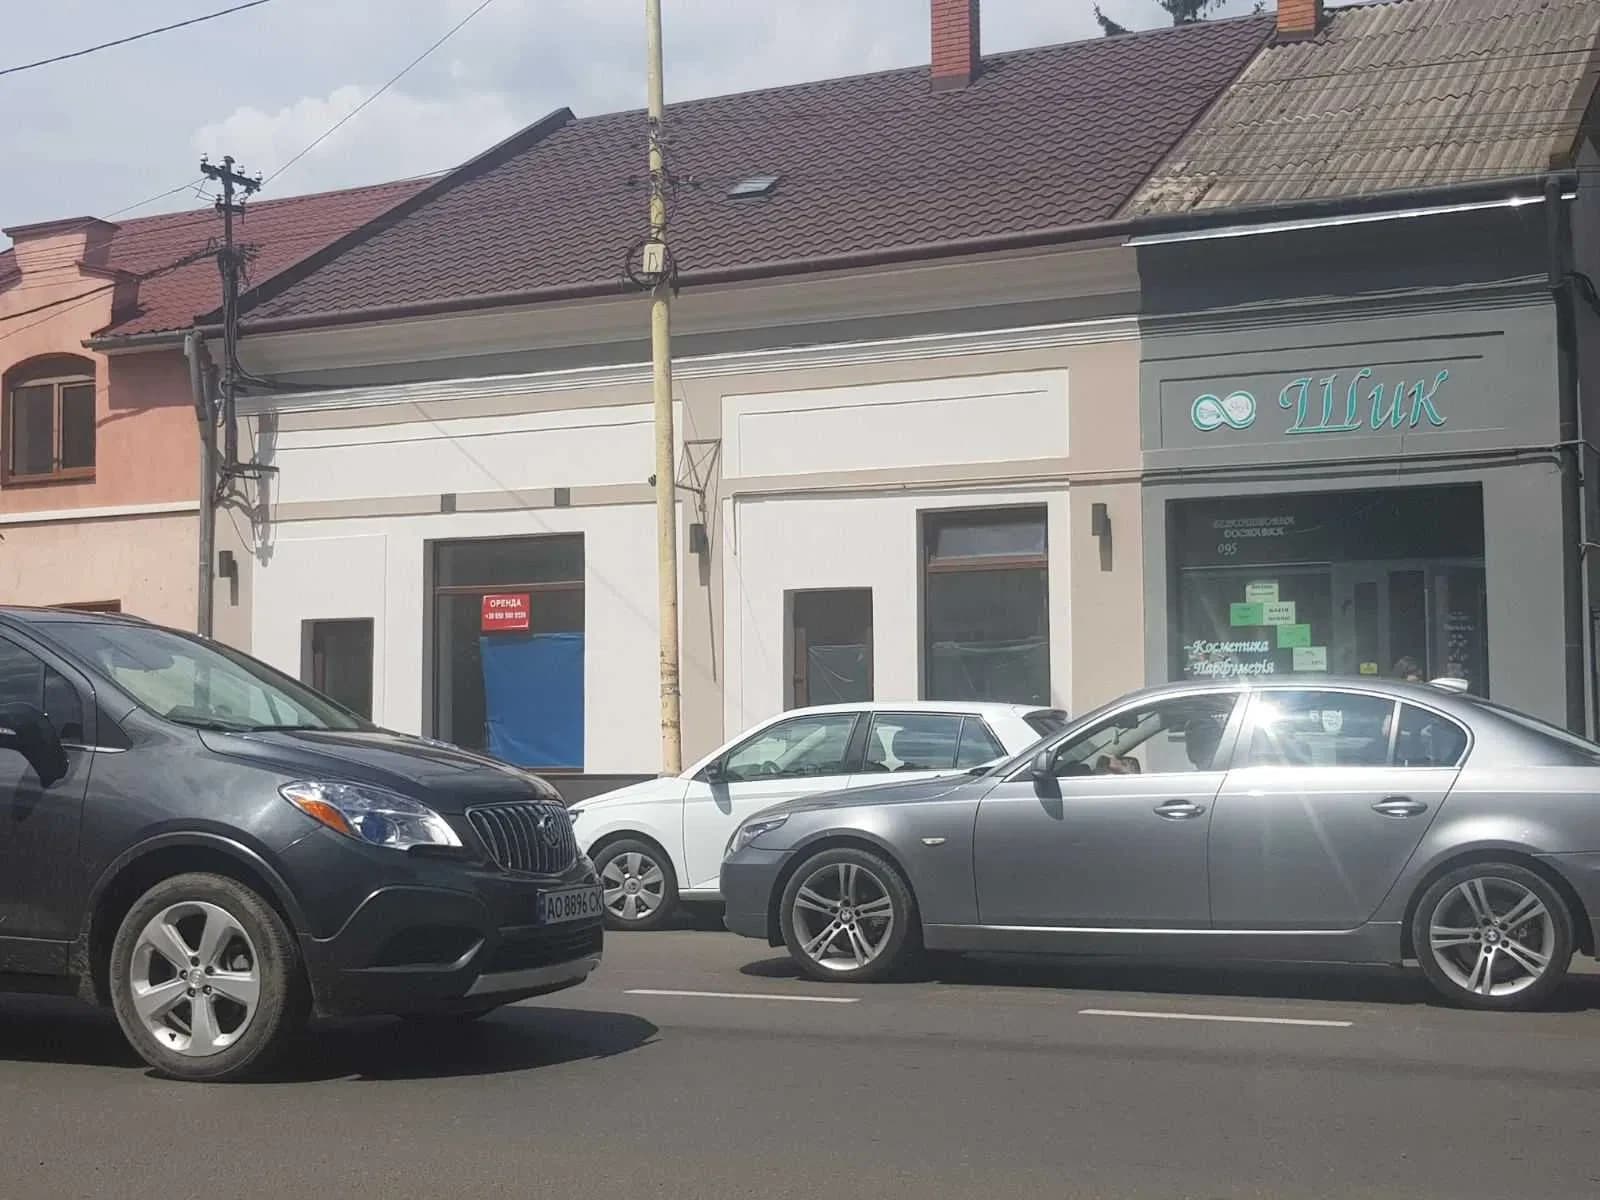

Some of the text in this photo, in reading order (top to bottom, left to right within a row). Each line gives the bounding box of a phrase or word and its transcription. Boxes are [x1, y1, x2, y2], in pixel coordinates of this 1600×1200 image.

[1279, 367, 1449, 435] Шик
[490, 599, 521, 608] ОРЕНДА
[1193, 640, 1269, 653] Косметика
[1193, 659, 1275, 678] Парфумерія
[548, 896, 563, 920] AO
[564, 892, 587, 916] 8896
